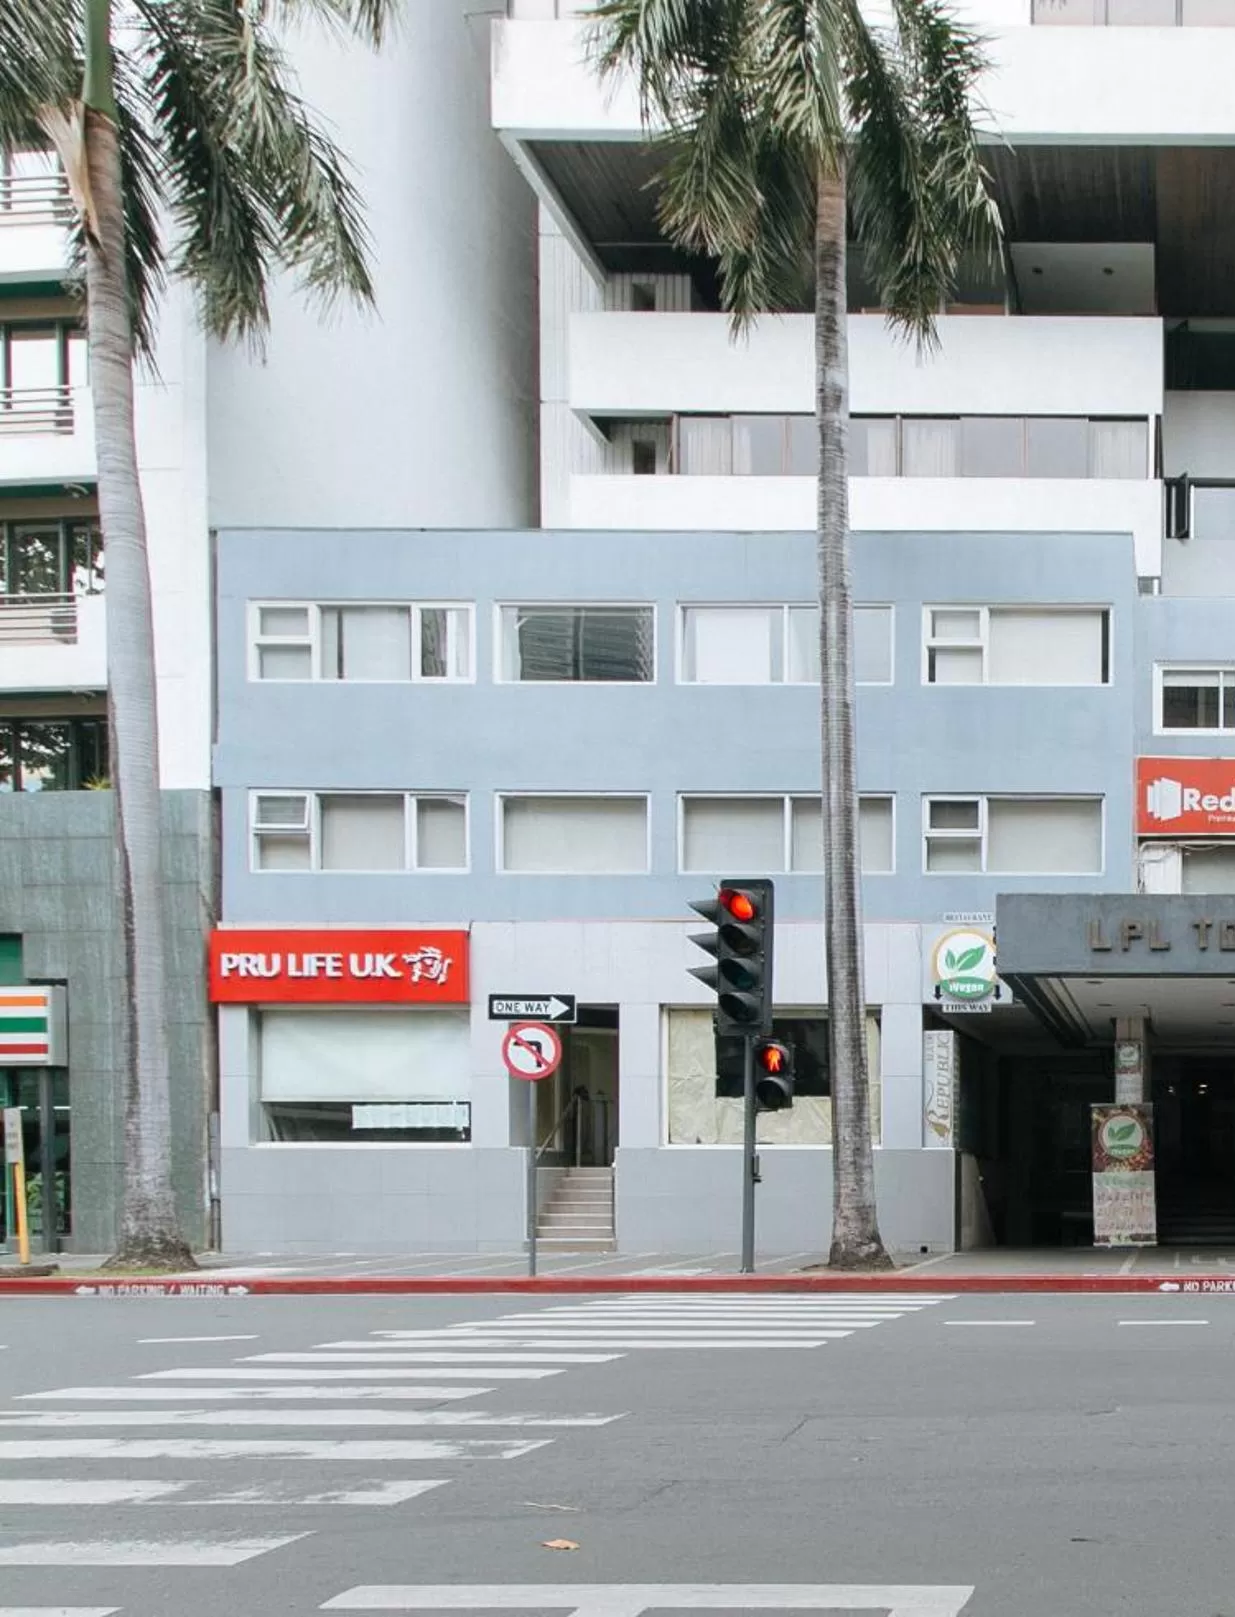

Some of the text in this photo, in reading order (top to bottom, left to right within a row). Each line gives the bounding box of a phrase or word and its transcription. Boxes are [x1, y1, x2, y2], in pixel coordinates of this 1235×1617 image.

[1088, 920, 1171, 953] LPL
[220, 953, 281, 978] PRU
[288, 953, 343, 978] LIFE
[496, 1002, 551, 1013] ONE WAY
[1184, 1281, 1199, 1292] NO
